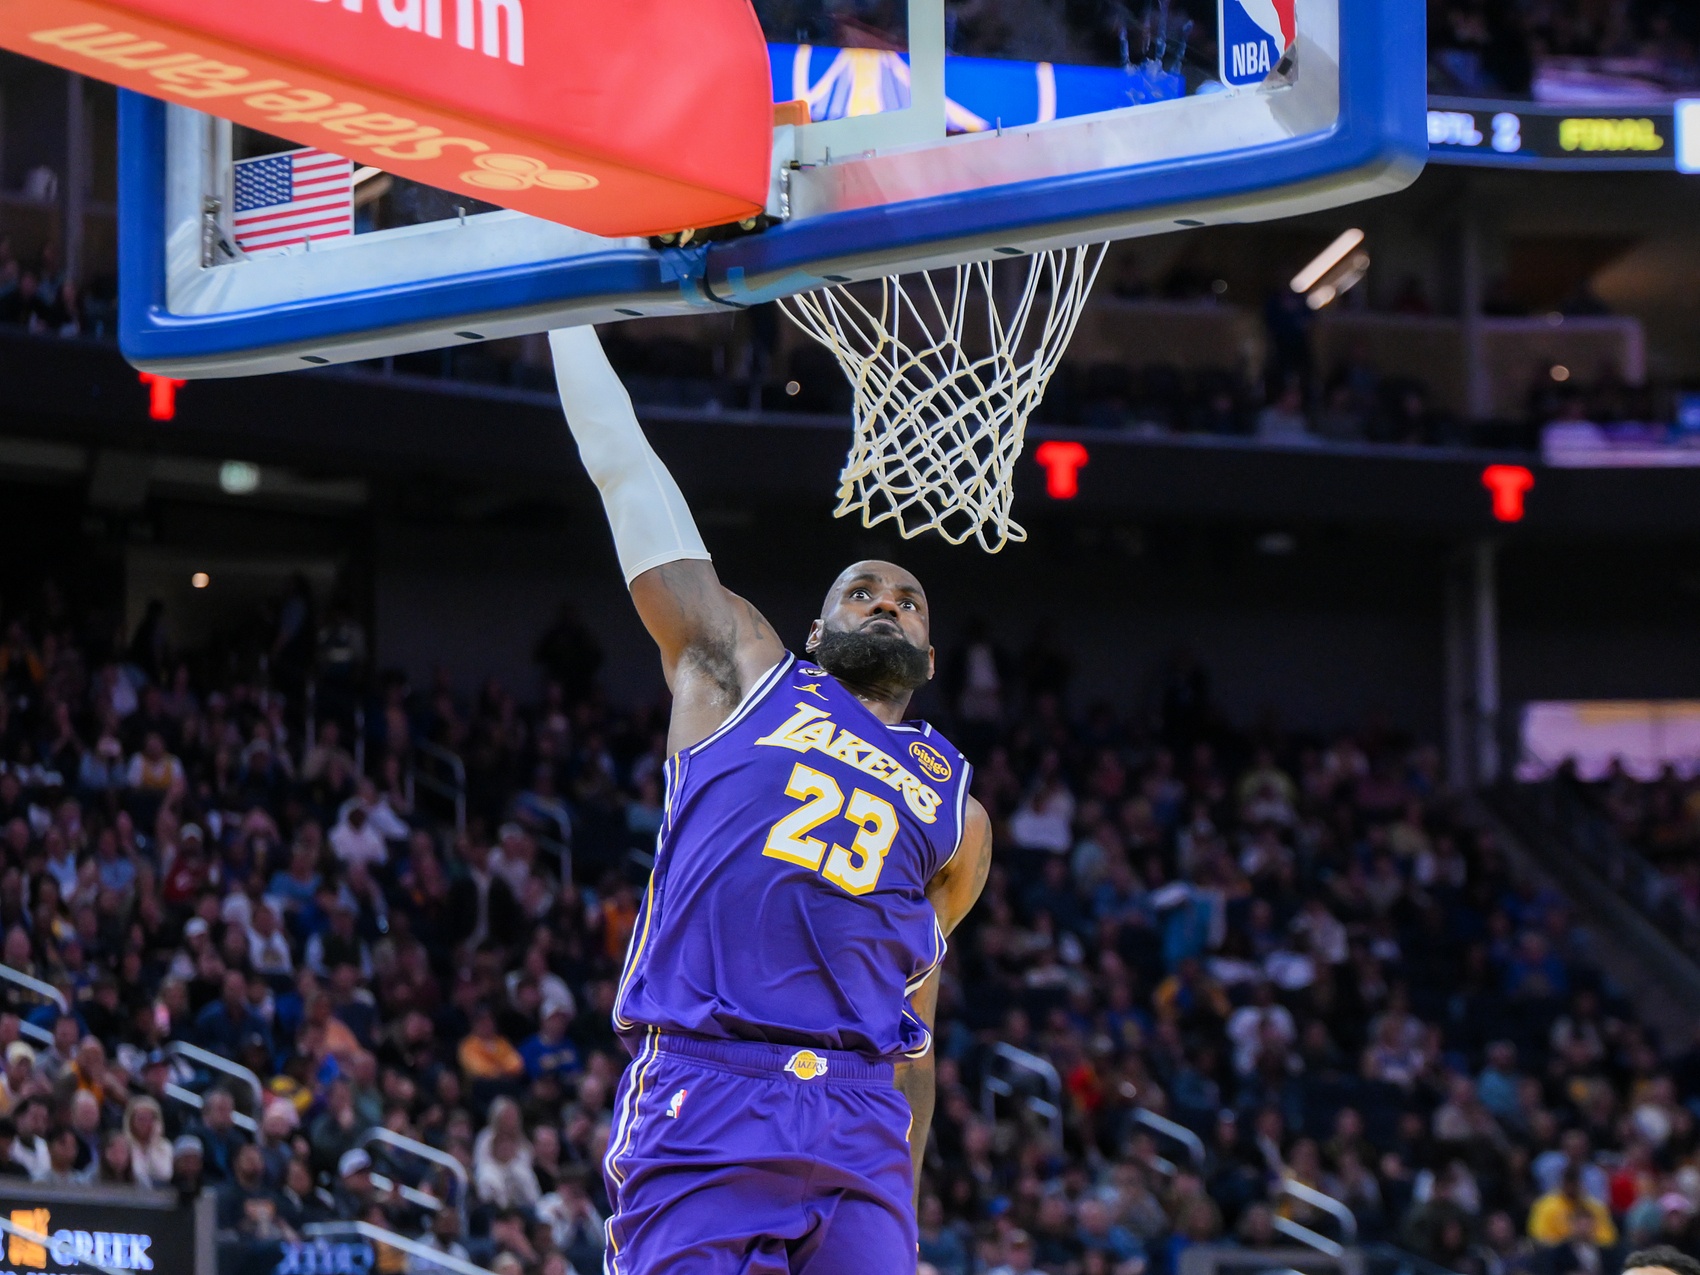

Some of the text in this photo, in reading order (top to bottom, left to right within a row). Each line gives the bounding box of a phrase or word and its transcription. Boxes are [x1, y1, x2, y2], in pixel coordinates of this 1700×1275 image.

[1232, 40, 1271, 77] NBA
[1559, 118, 1664, 150] FINAL
[754, 702, 943, 824] LAKERS
[913, 745, 949, 776] bibigo
[762, 762, 900, 896] 23
